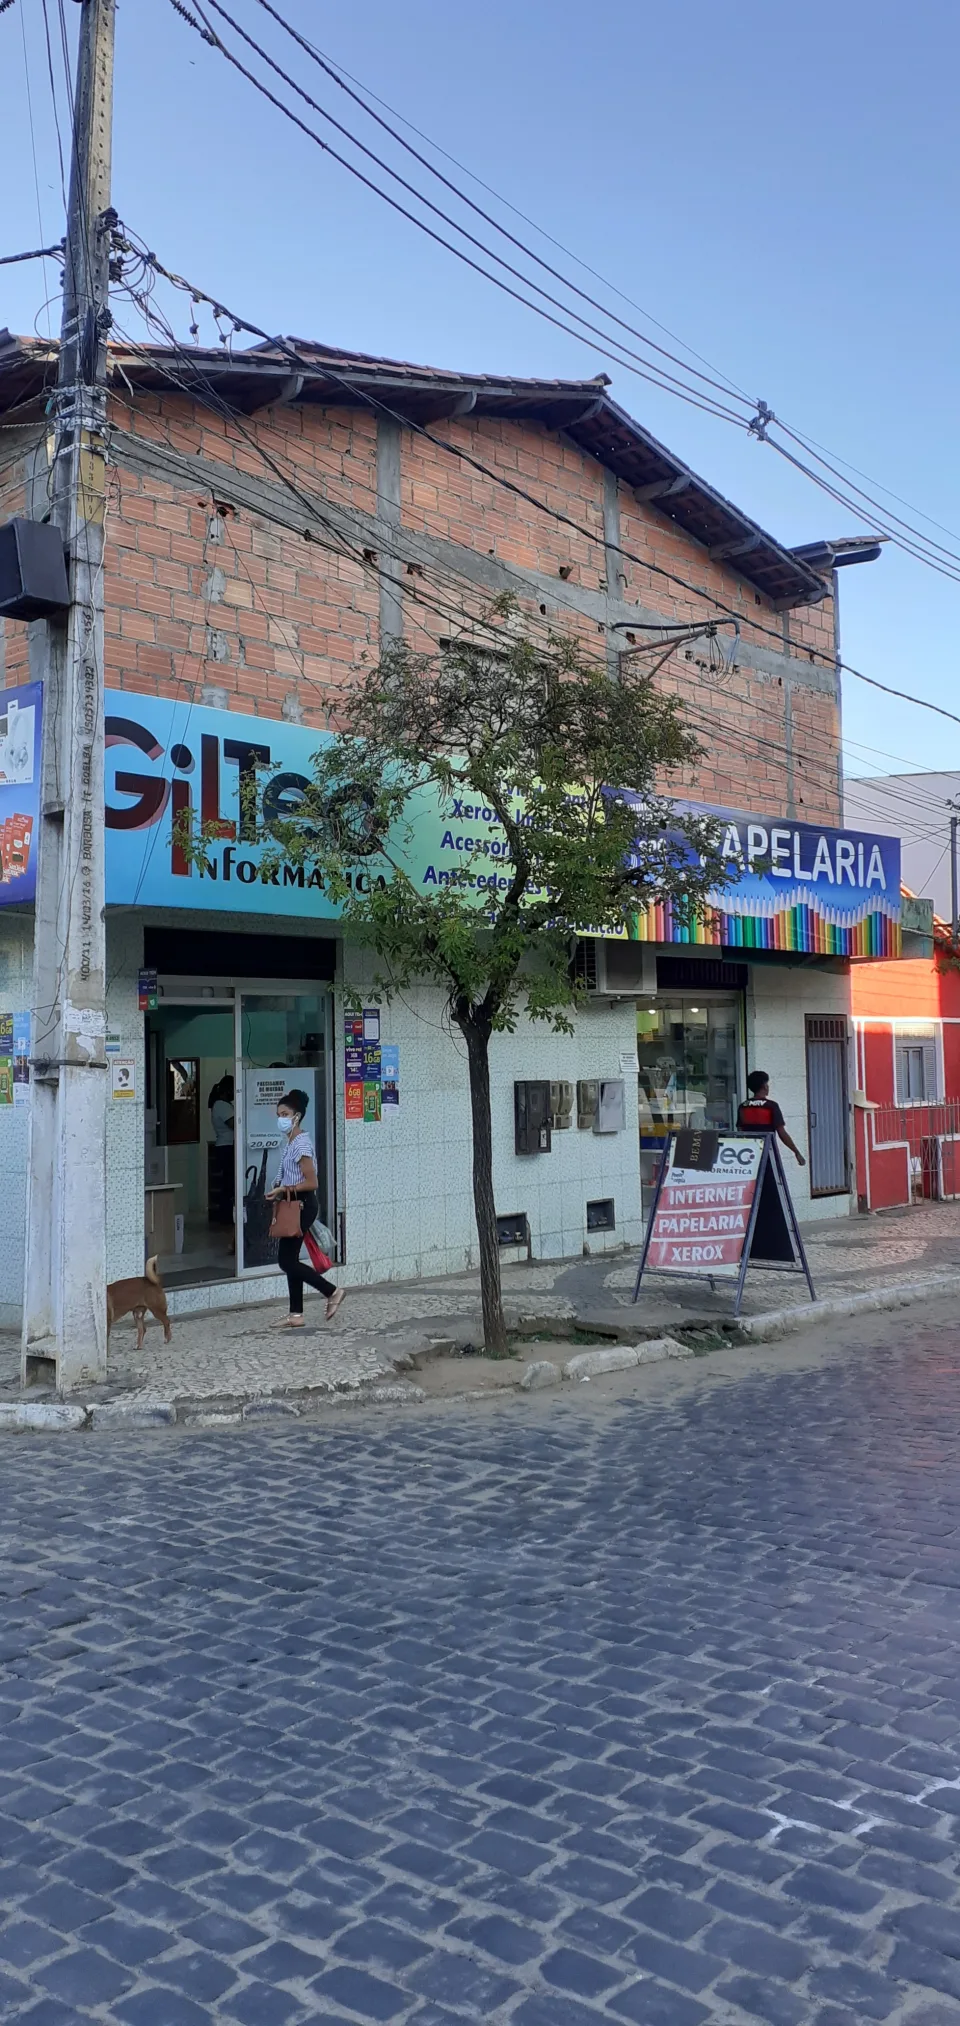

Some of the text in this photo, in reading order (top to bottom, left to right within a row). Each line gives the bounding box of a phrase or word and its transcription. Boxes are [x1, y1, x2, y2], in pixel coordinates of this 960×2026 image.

[440, 831, 513, 857] Acessór
[700, 821, 887, 890] APELARIA
[250, 1140, 278, 1149] 20,00
[711, 1142, 756, 1166] Tec
[668, 1185, 747, 1206] INTERNET
[657, 1213, 745, 1234] PAPELARIA
[671, 1244, 724, 1262] XEROX
